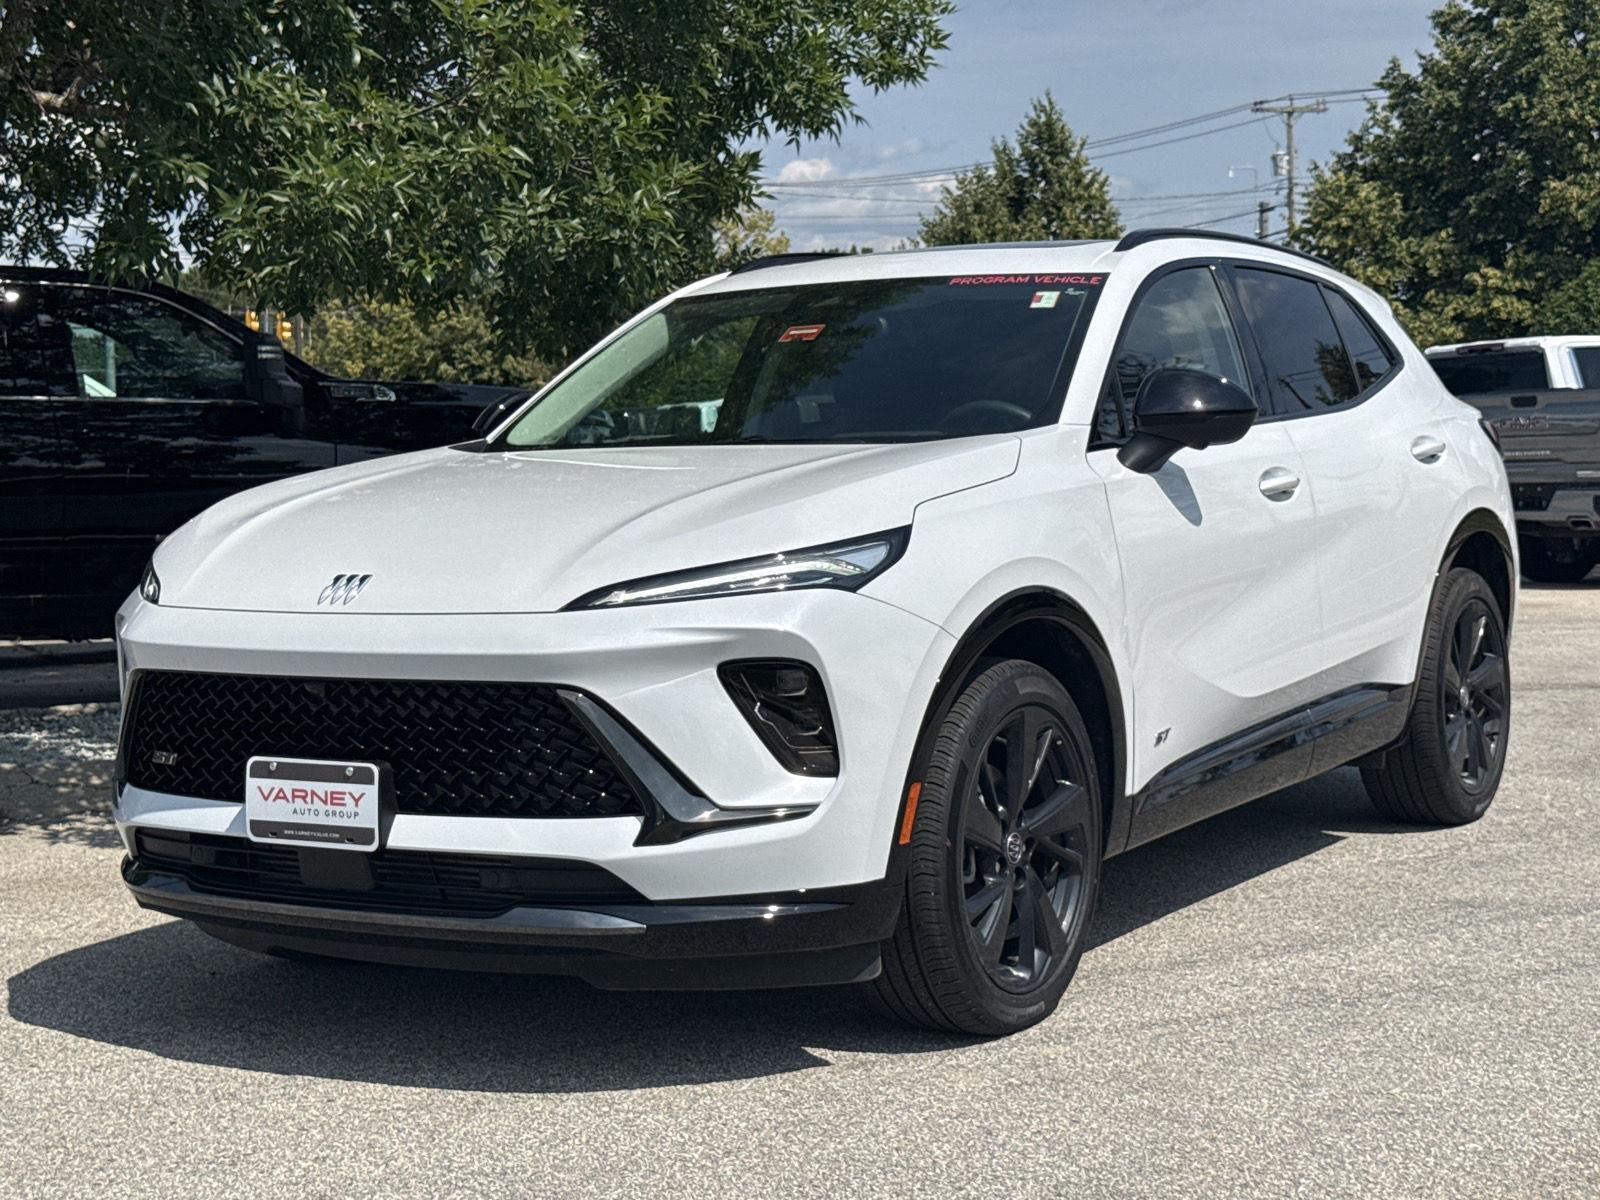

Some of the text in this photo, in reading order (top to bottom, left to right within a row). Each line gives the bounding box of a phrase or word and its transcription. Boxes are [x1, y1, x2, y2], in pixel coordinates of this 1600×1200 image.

[949, 274, 1103, 285] PROGRAM VEHICLE
[257, 785, 366, 808] VARNEY
[292, 806, 360, 820] AUTO GROUP
